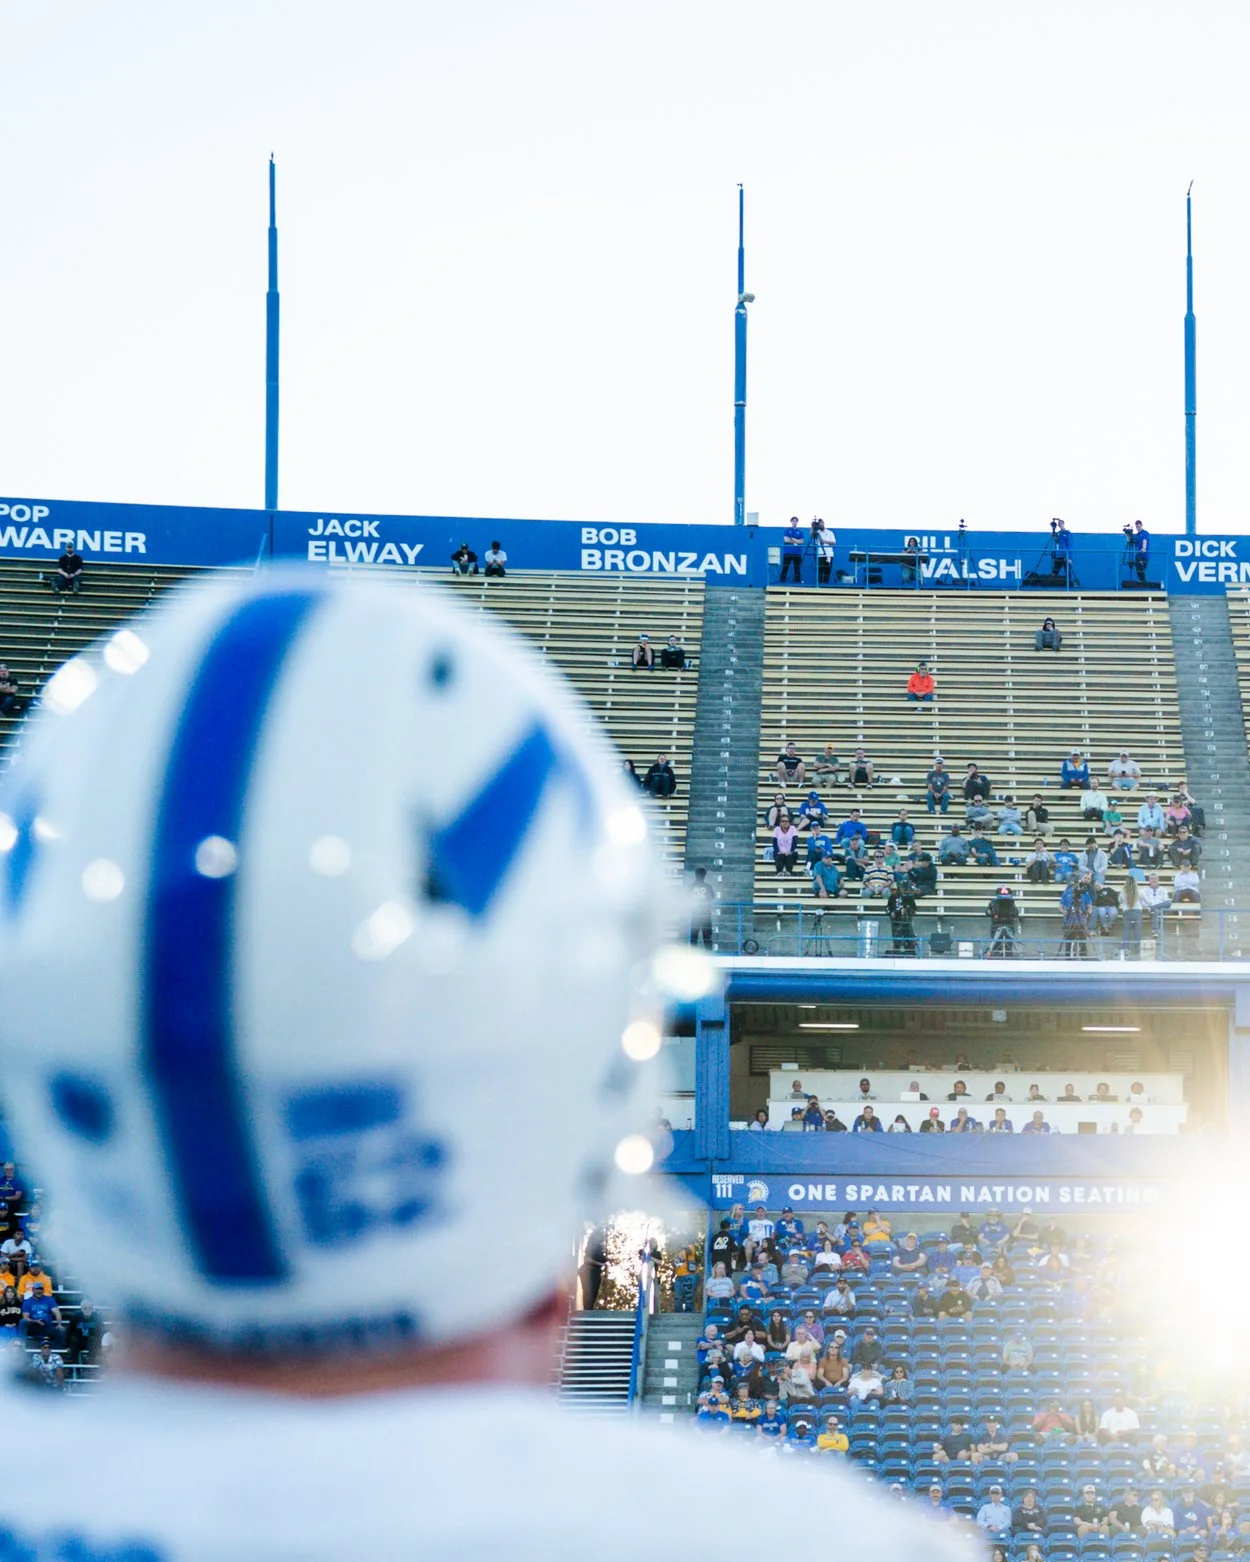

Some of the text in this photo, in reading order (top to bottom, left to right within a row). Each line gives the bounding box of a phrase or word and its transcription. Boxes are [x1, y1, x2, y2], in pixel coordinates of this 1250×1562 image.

[0, 503, 50, 523] POP
[308, 519, 380, 538] JACK
[581, 527, 638, 546] BOB
[0, 526, 147, 553] WARNER
[1175, 540, 1237, 558] DICK
[308, 540, 424, 565] ELWAY
[581, 549, 748, 576] BRONZAN
[711, 1174, 744, 1185] RESERVED
[715, 1184, 733, 1199] 111
[788, 1184, 1161, 1203] ONE SPARTAN NATION SEATING
